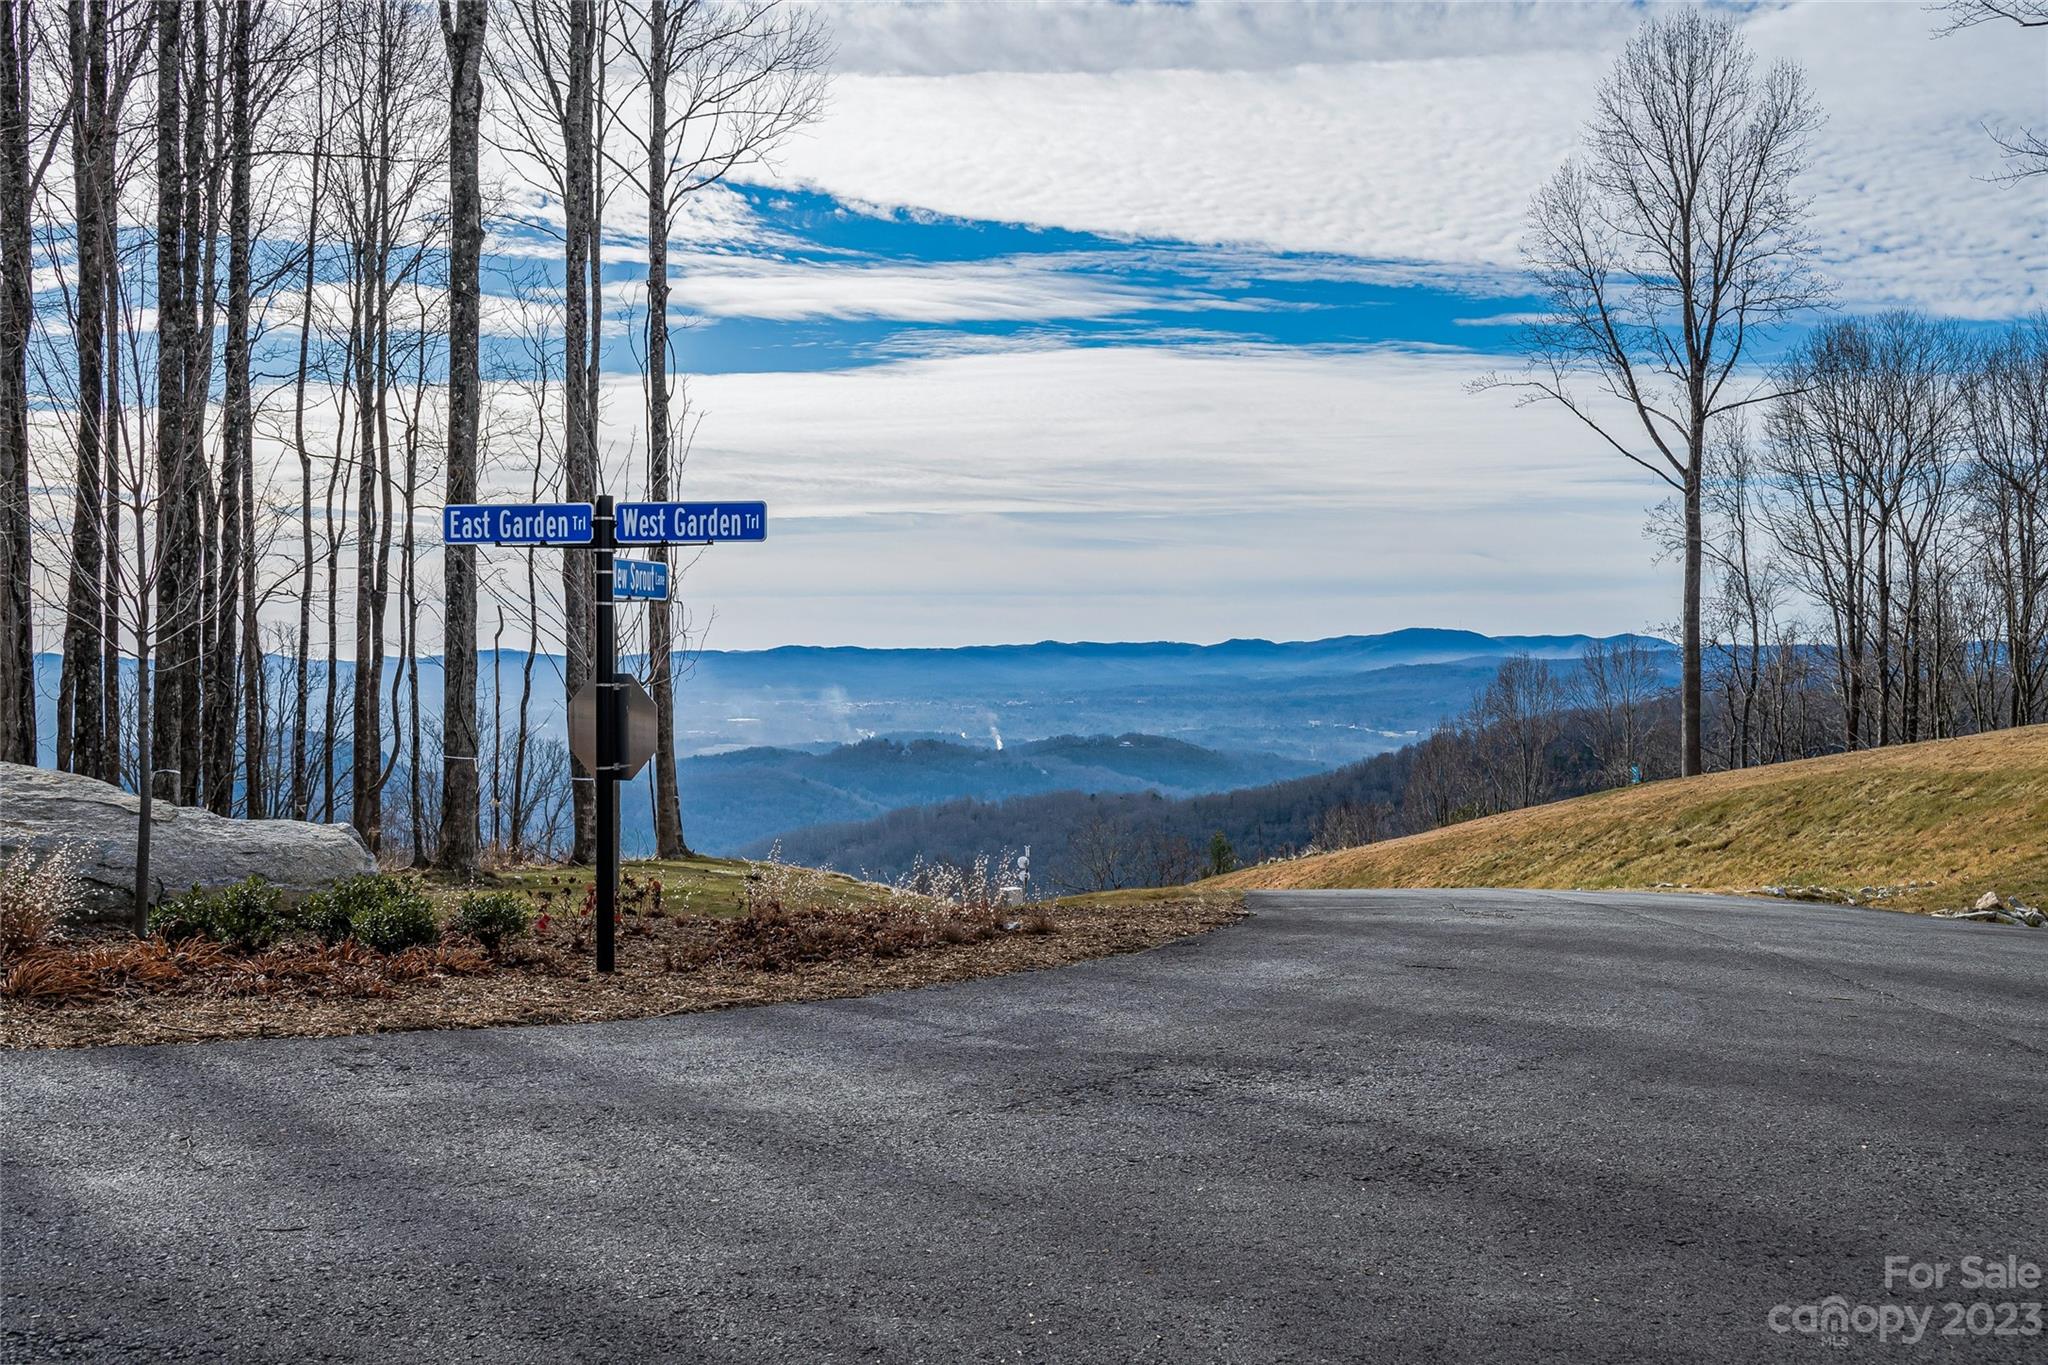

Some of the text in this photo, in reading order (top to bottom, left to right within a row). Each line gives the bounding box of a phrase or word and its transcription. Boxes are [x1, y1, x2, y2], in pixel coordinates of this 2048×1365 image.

[450, 509, 586, 539] East Garden Trl
[623, 508, 759, 537] West Garden Trl
[630, 562, 655, 593] Sprout
[655, 571, 665, 586] Lane
